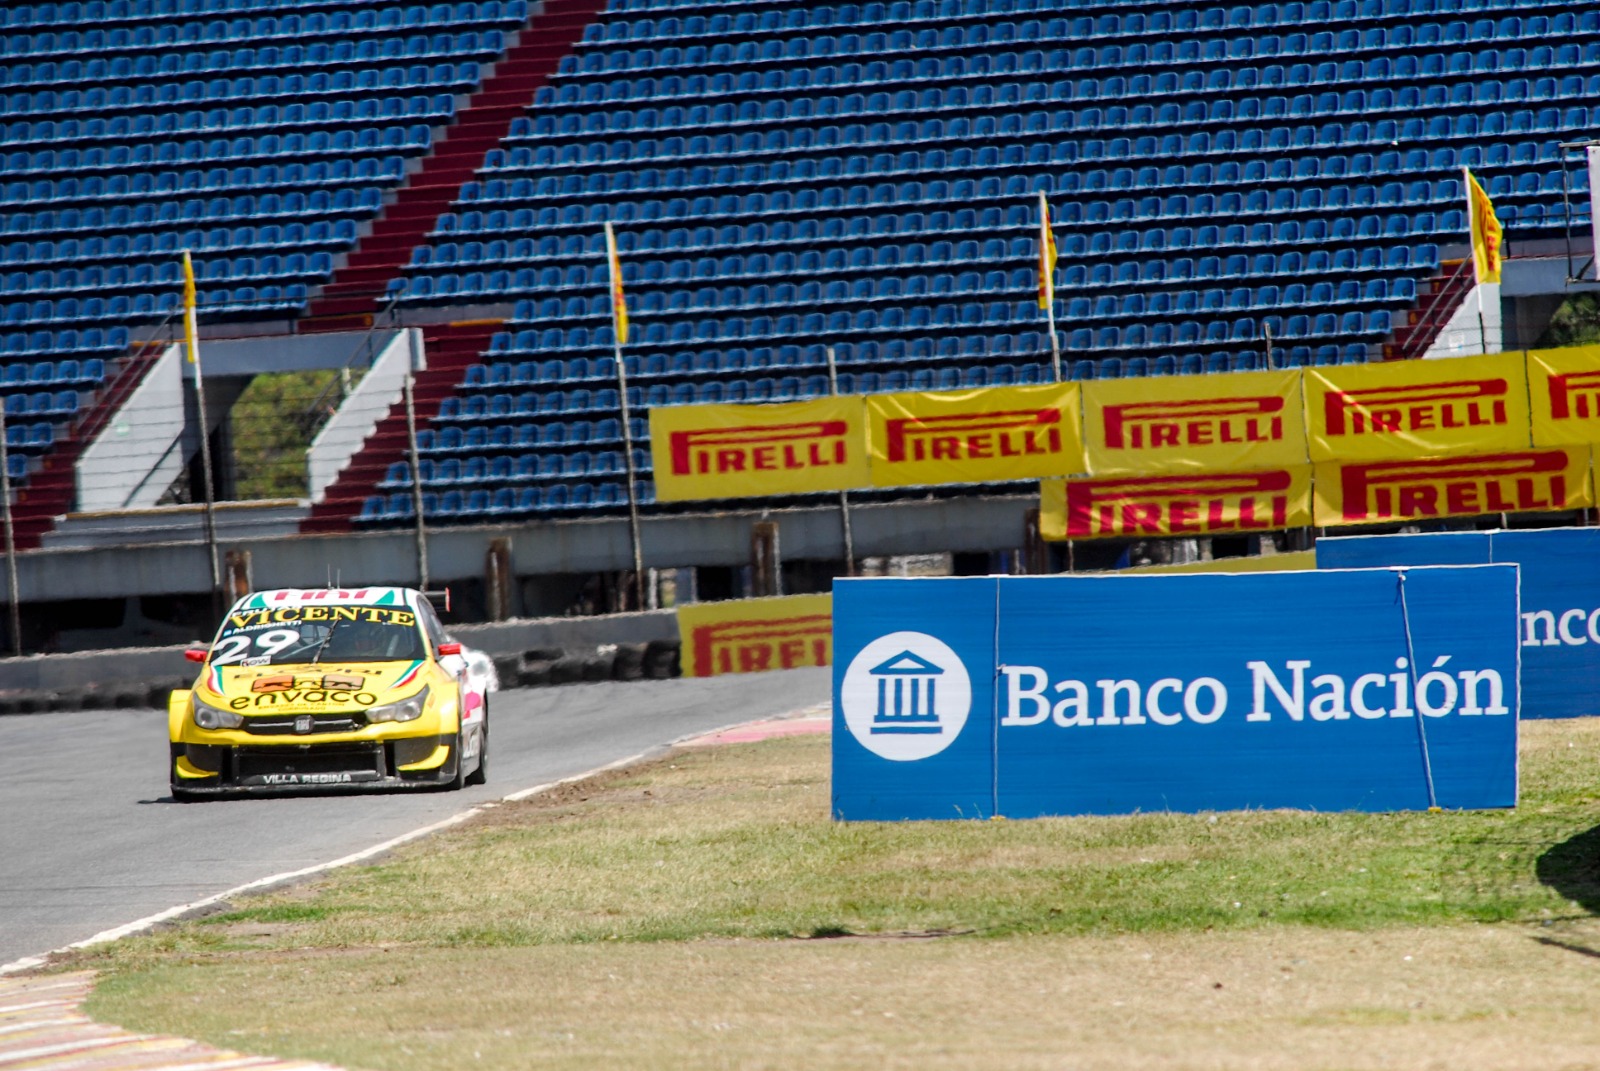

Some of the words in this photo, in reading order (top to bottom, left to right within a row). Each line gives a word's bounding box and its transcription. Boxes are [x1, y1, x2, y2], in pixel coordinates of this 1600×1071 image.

[1102, 396, 1285, 450] PIRELLI
[1324, 377, 1510, 437] PIRELLI
[669, 420, 848, 476] PIRELLI
[885, 408, 1063, 463] PIRELLI
[1065, 470, 1292, 538] PIRELLI
[1341, 450, 1570, 523] PIRELLI
[230, 605, 416, 627] VICENTE
[209, 629, 300, 667] 29
[229, 689, 378, 710] envaco
[1002, 665, 1228, 728] Banco
[1247, 655, 1509, 721] Nación
[263, 774, 299, 785] VILLA
[302, 773, 352, 784] REGINA
